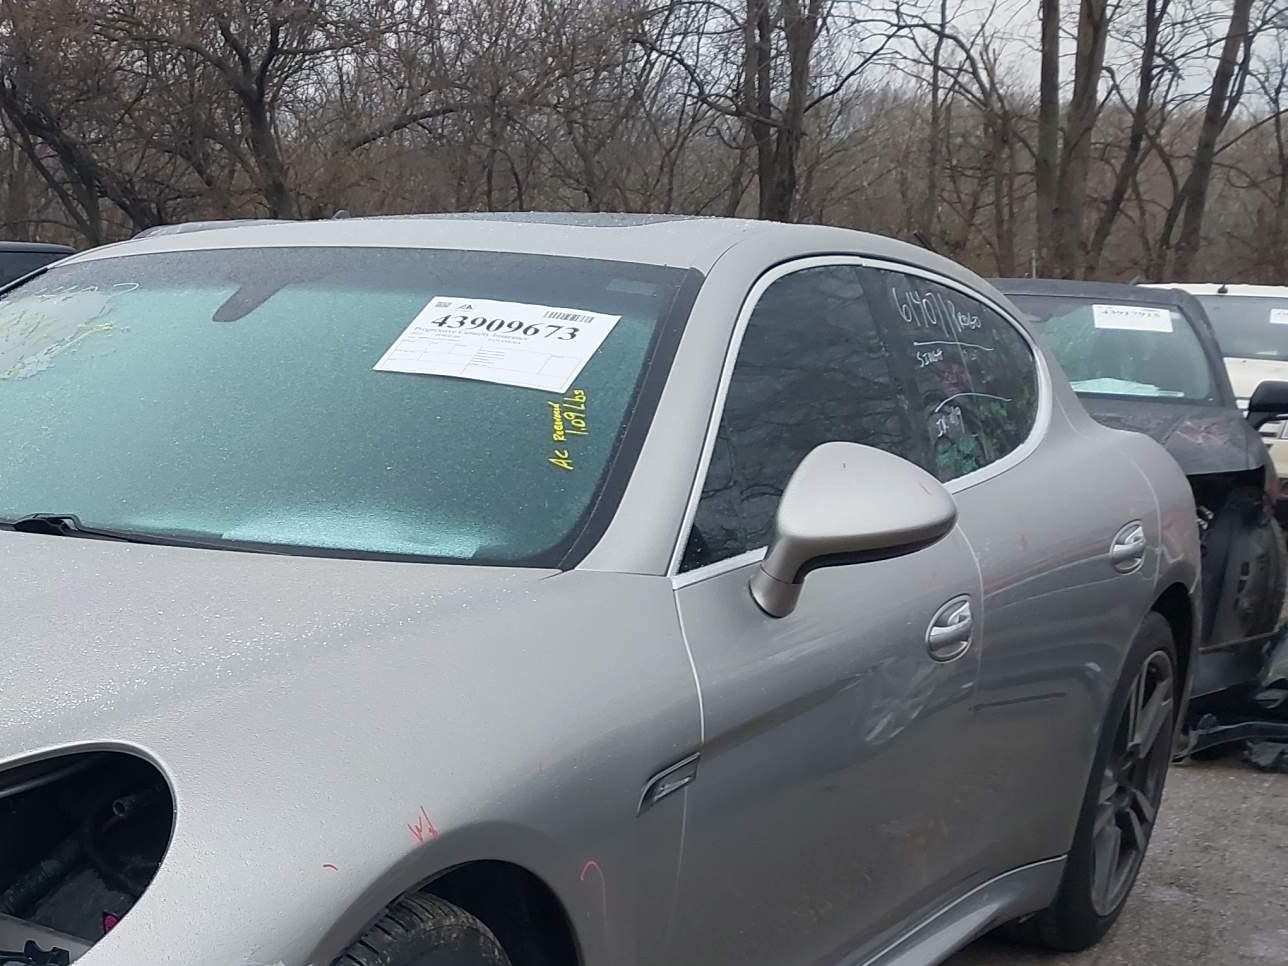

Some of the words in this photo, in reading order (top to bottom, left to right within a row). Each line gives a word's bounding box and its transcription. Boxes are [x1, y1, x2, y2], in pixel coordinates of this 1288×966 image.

[431, 314, 580, 341] 43909673
[563, 411, 590, 435] 1.09
[548, 450, 574, 470] AC
